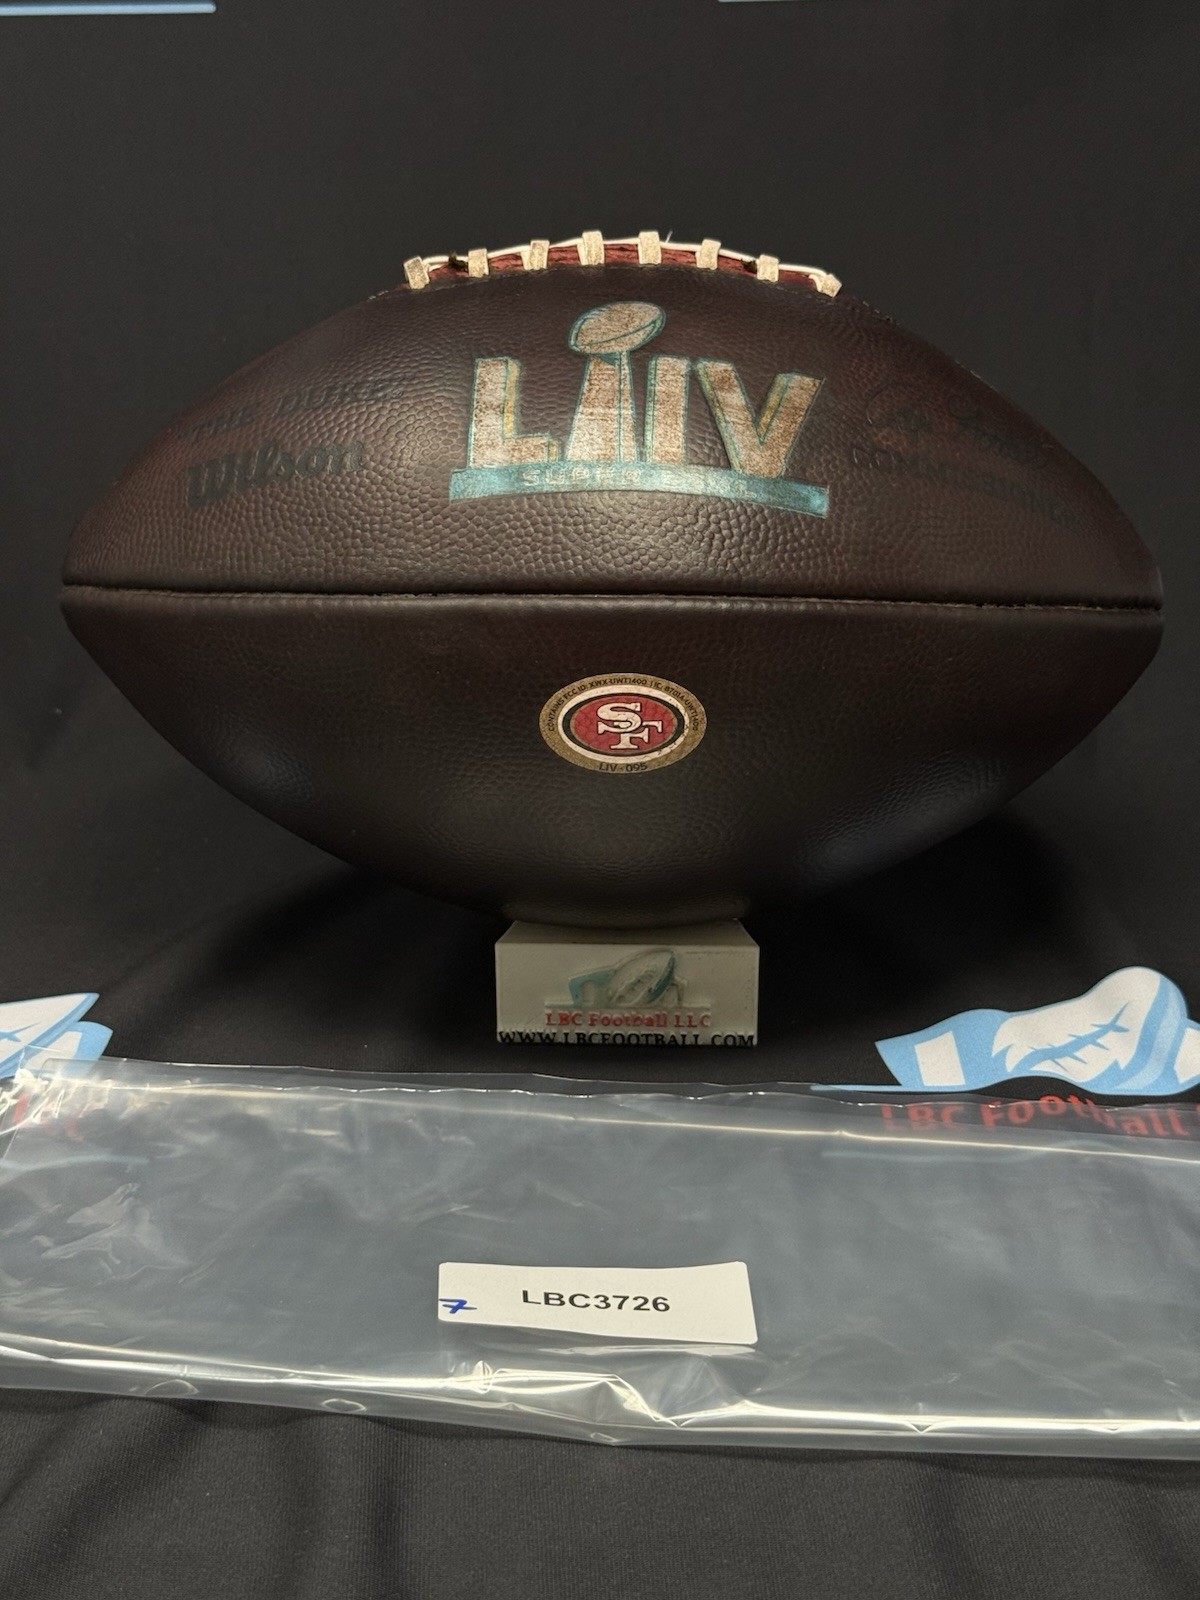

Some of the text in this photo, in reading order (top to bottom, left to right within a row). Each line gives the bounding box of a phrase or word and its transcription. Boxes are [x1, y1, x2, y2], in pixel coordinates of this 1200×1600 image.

[467, 354, 826, 478] LIV
[187, 438, 364, 508] Wilson
[522, 465, 641, 488] SUPER
[563, 688, 578, 700] FCC
[625, 762, 648, 772] 095
[545, 1011, 711, 1028] LBC Football LLC
[521, 1289, 671, 1313] LBC3726
